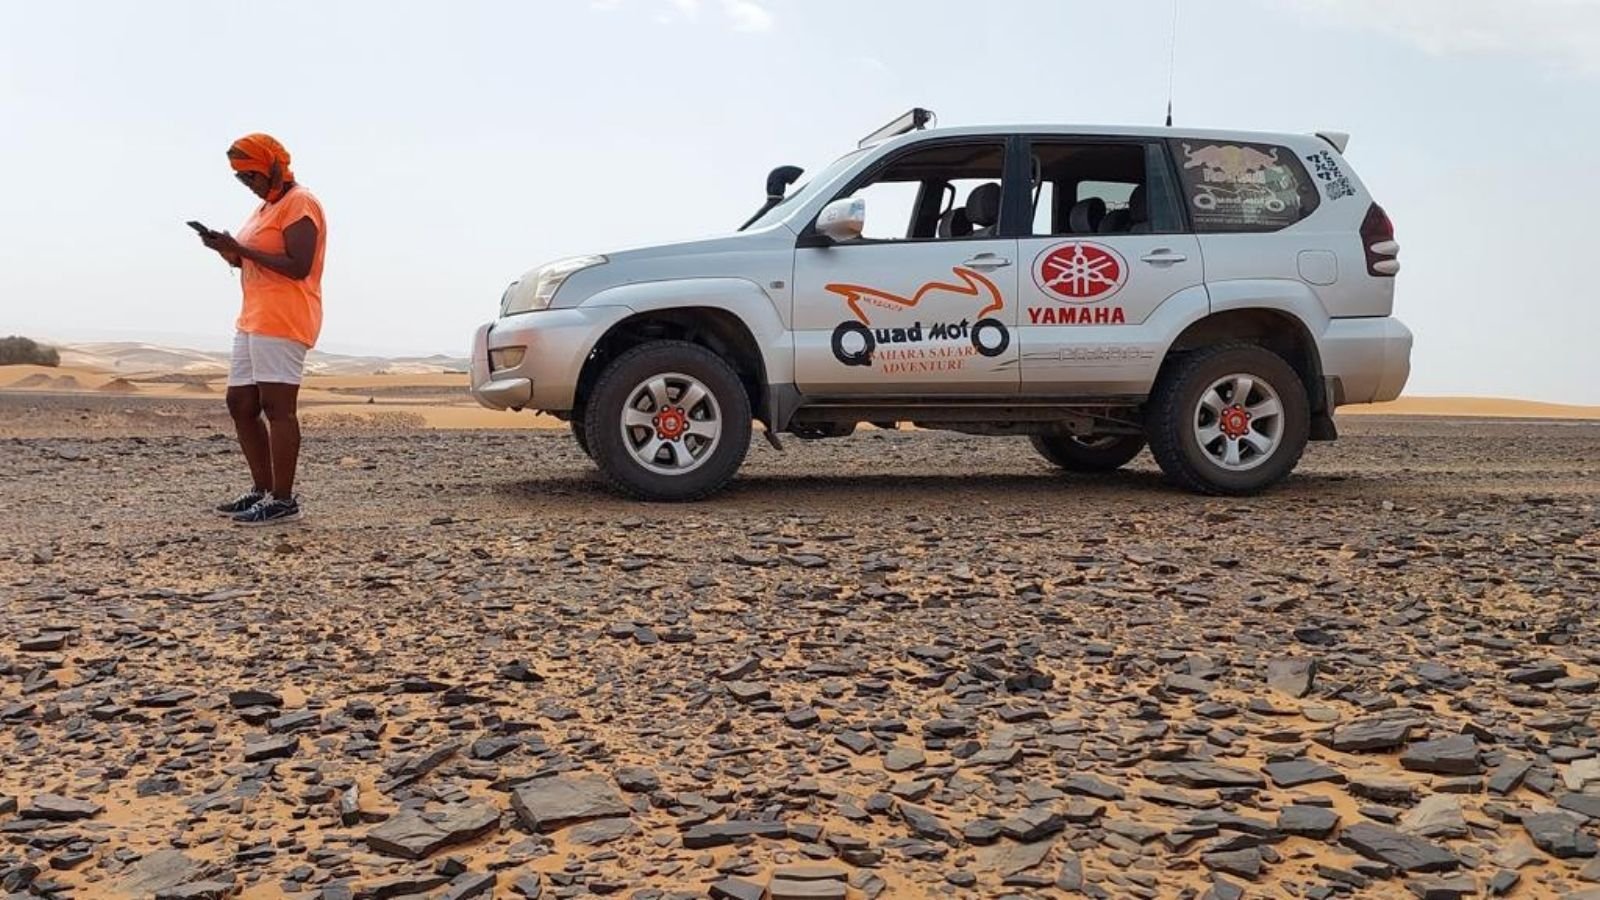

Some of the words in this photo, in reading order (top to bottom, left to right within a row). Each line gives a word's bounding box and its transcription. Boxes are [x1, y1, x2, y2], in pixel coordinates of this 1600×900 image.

[1027, 307, 1125, 325] YAMAHA
[831, 320, 922, 366] Quad
[881, 359, 965, 374] ADVENTURE
